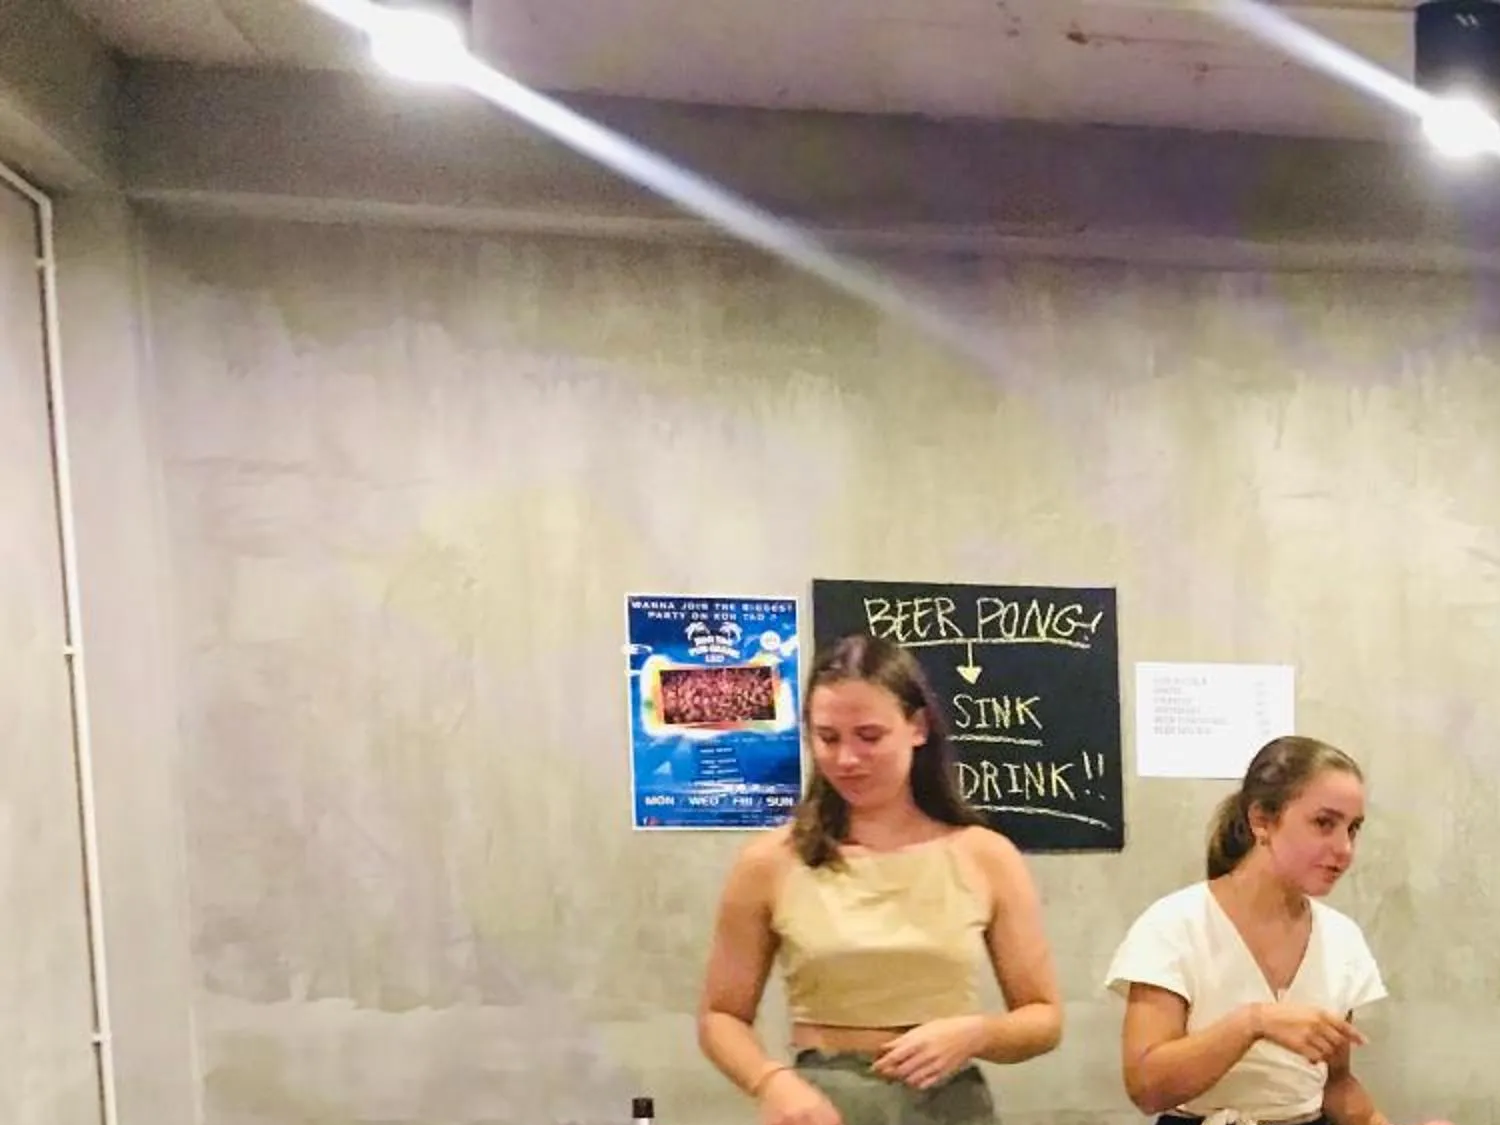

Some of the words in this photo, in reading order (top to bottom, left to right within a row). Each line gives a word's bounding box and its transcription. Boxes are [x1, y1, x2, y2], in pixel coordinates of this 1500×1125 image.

[631, 601, 675, 610] WANNA
[681, 602, 709, 611] JOIN
[713, 603, 736, 611] THE
[741, 603, 794, 613] BIGGEST
[647, 611, 685, 620] PARTY
[691, 612, 709, 620] ON
[713, 612, 737, 621] KOH
[864, 598, 963, 640] BEER
[953, 694, 1043, 730] SINK
[644, 796, 675, 807] MON
[687, 796, 719, 807] WED
[732, 797, 753, 807] FRI
[765, 796, 794, 807] SUN
